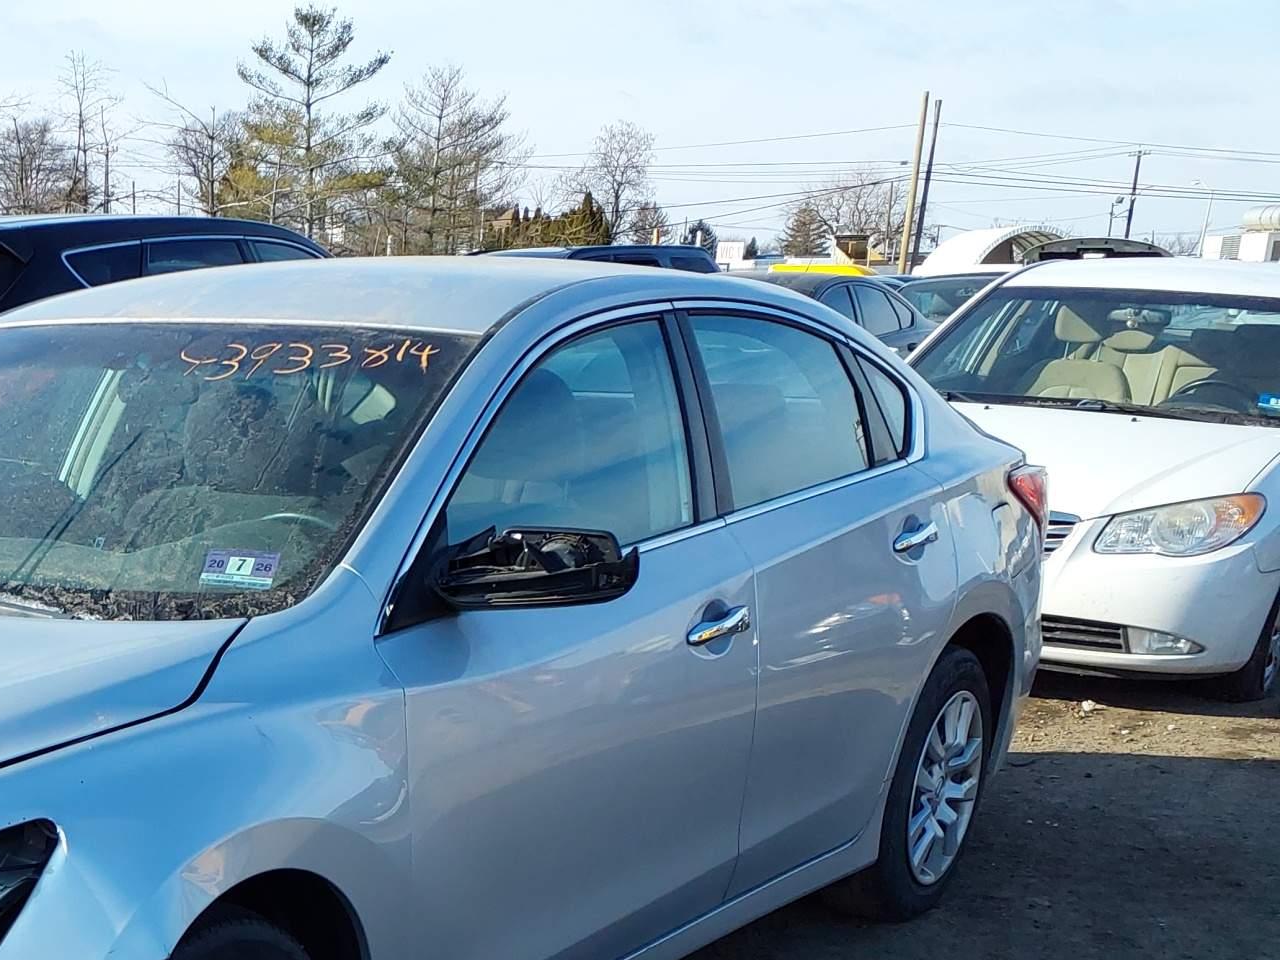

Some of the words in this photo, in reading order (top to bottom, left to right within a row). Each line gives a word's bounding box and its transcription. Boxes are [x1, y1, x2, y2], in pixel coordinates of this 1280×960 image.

[207, 559, 225, 569] 20
[236, 558, 247, 572] 7
[255, 562, 273, 573] 26
